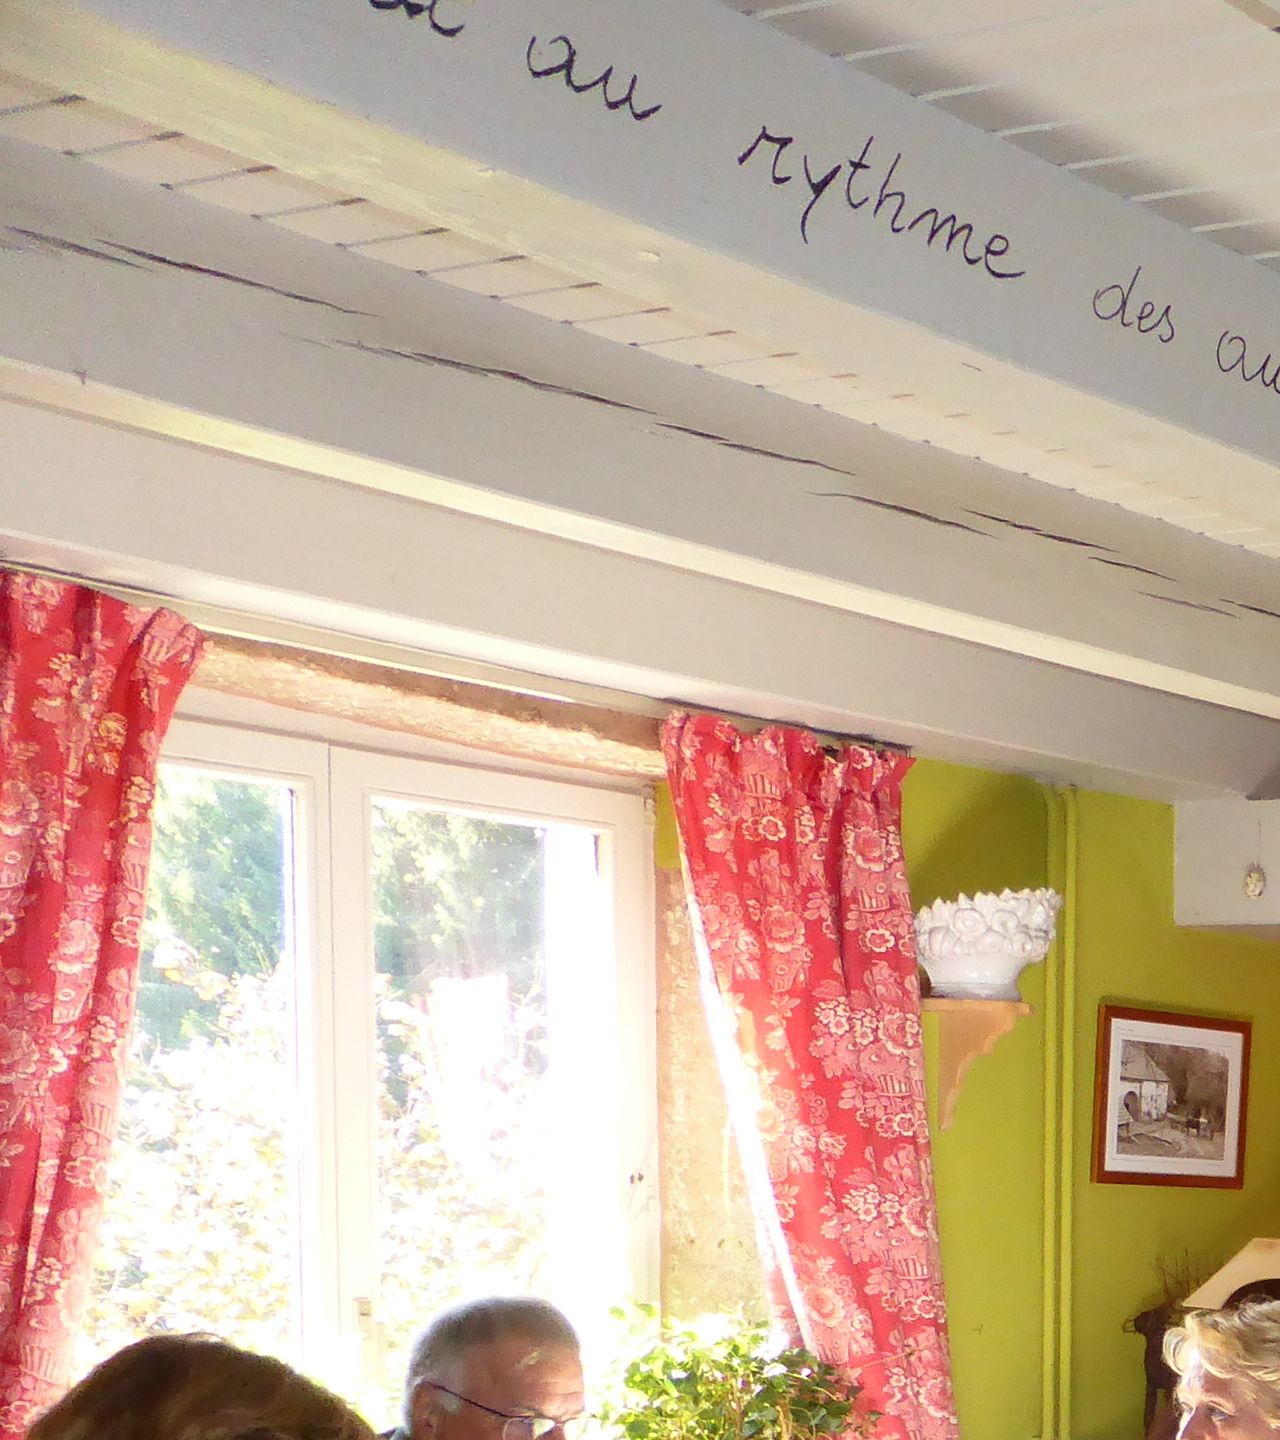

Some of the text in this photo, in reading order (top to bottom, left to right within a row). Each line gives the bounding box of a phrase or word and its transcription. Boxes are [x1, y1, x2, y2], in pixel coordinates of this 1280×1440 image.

[527, 36, 662, 121] au
[737, 126, 1026, 279] rythme
[1092, 266, 1177, 344] des
